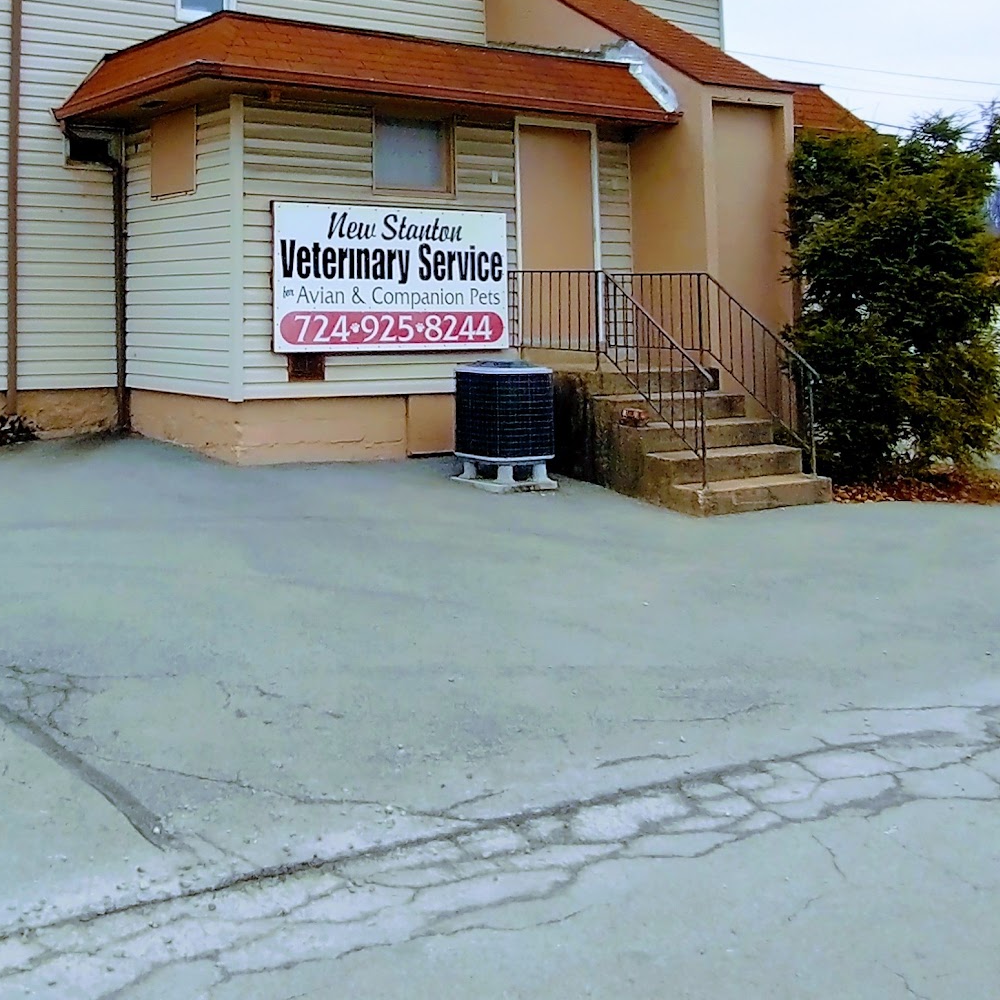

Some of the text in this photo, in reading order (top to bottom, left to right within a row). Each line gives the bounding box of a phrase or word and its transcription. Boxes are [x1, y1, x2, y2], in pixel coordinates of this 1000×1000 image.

[327, 211, 463, 243] New Stanton
[280, 239, 503, 284] Veterinary Service
[296, 286, 345, 305] Avian
[352, 287, 366, 305] &
[372, 287, 464, 309] Companion
[470, 288, 500, 306] Pets
